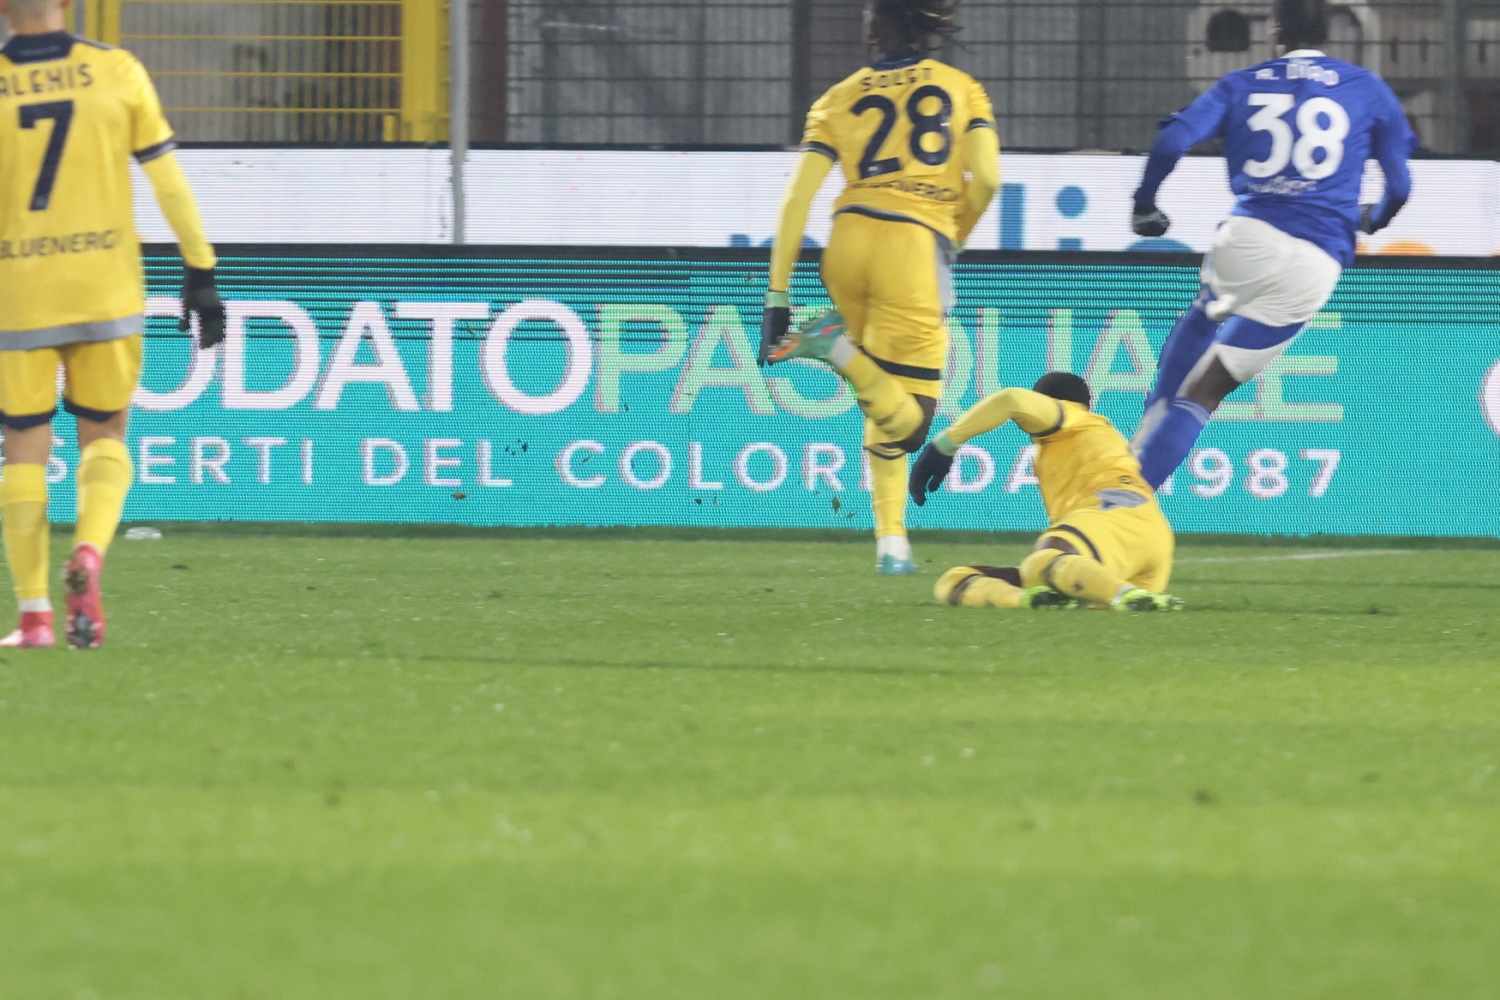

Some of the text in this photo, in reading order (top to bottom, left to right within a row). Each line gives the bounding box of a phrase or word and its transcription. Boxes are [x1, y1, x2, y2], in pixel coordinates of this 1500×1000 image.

[17, 98, 74, 212] 7
[850, 84, 953, 180] 28
[1242, 92, 1350, 180] 38
[360, 439, 512, 488] DEL
[557, 440, 873, 492] COLOR
[943, 443, 1042, 494] DA
[1157, 448, 1341, 500] 987
